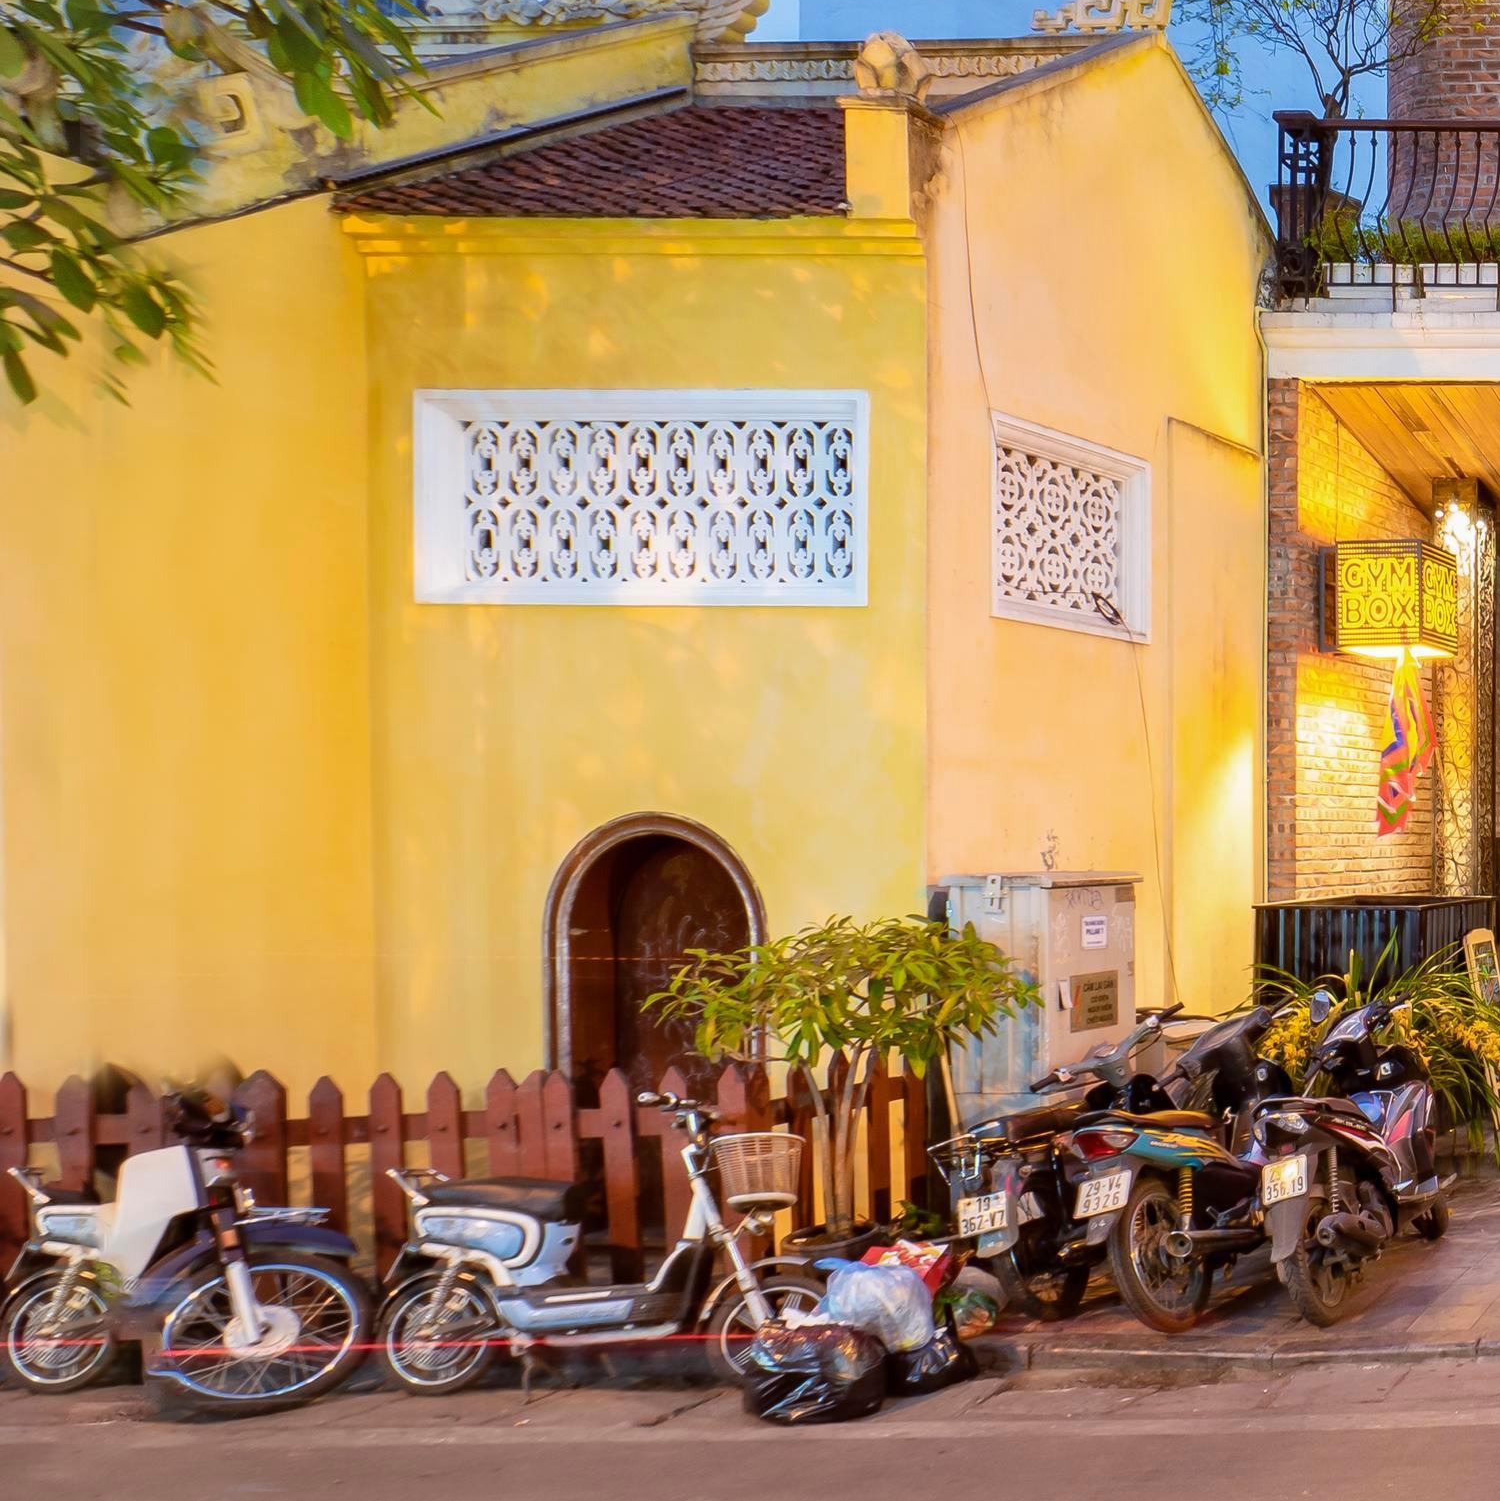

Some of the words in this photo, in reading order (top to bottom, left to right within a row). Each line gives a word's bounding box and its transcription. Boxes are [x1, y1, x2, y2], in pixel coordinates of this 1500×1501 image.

[1341, 557, 1417, 594] GYM
[1422, 560, 1457, 603] GYM
[1341, 592, 1417, 628] BOX
[1422, 594, 1457, 636] BOX
[1082, 1190, 1120, 1214] 9326
[1085, 1174, 1123, 1199] 29-V4
[961, 1210, 1006, 1236] 362-V7
